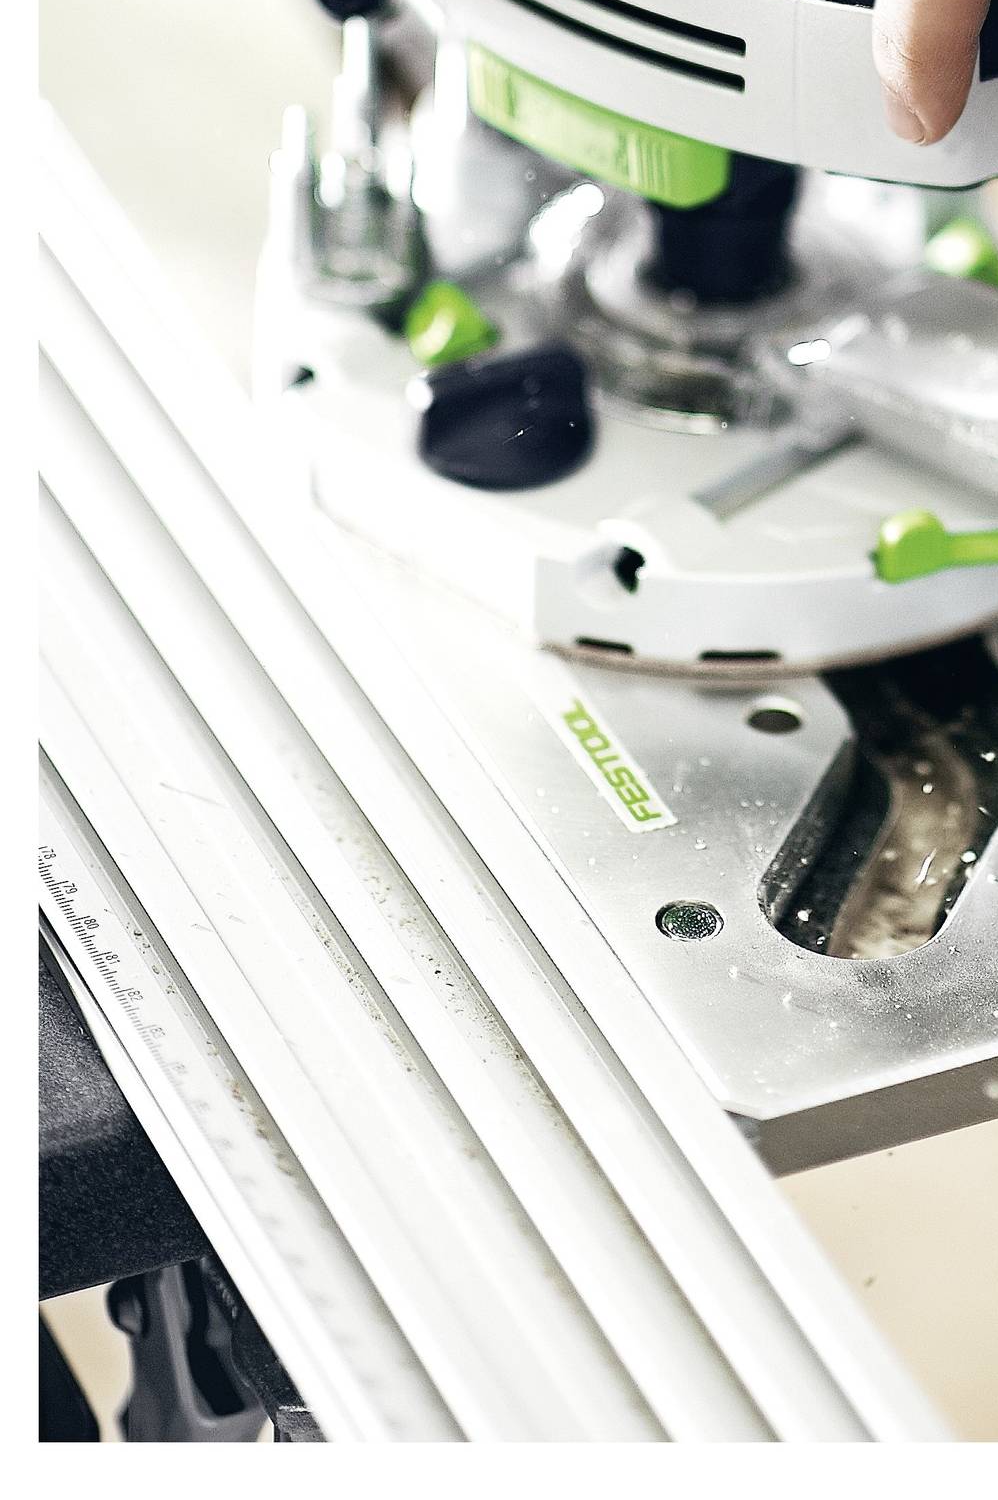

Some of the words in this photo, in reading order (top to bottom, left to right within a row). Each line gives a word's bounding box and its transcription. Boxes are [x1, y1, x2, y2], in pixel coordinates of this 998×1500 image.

[561, 697, 663, 822] FESTOOL
[62, 882, 78, 895] 79
[83, 918, 100, 930] 80
